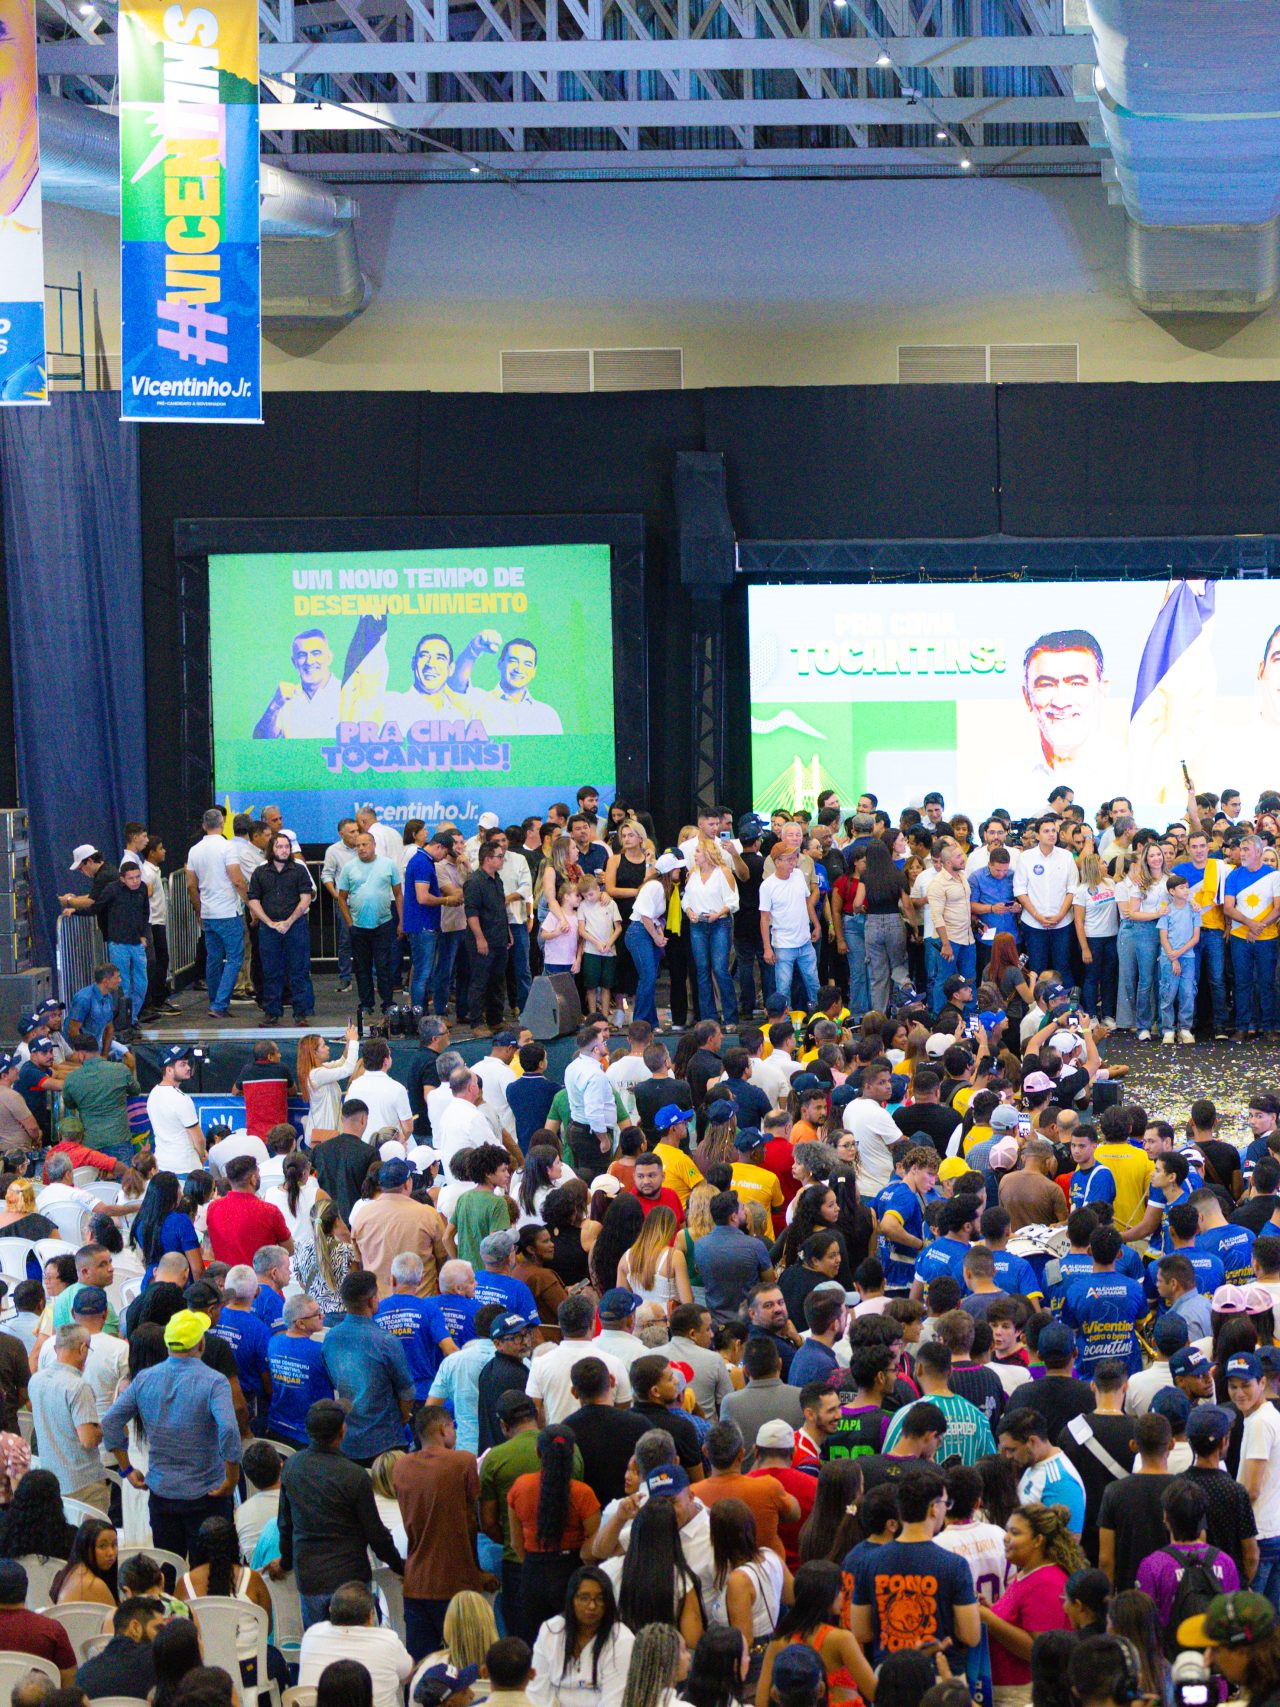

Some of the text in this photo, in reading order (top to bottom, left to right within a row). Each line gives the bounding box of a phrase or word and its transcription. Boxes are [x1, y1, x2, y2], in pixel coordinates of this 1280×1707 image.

[131, 375, 251, 398] Vicentinho Jr.
[292, 566, 525, 590] UM NOVO TEMPO DE
[293, 592, 527, 616] DESENVOLVIMENTO
[336, 721, 404, 745] PRA
[321, 742, 511, 773] TOCANTINS!
[875, 1574, 938, 1596] PONO
